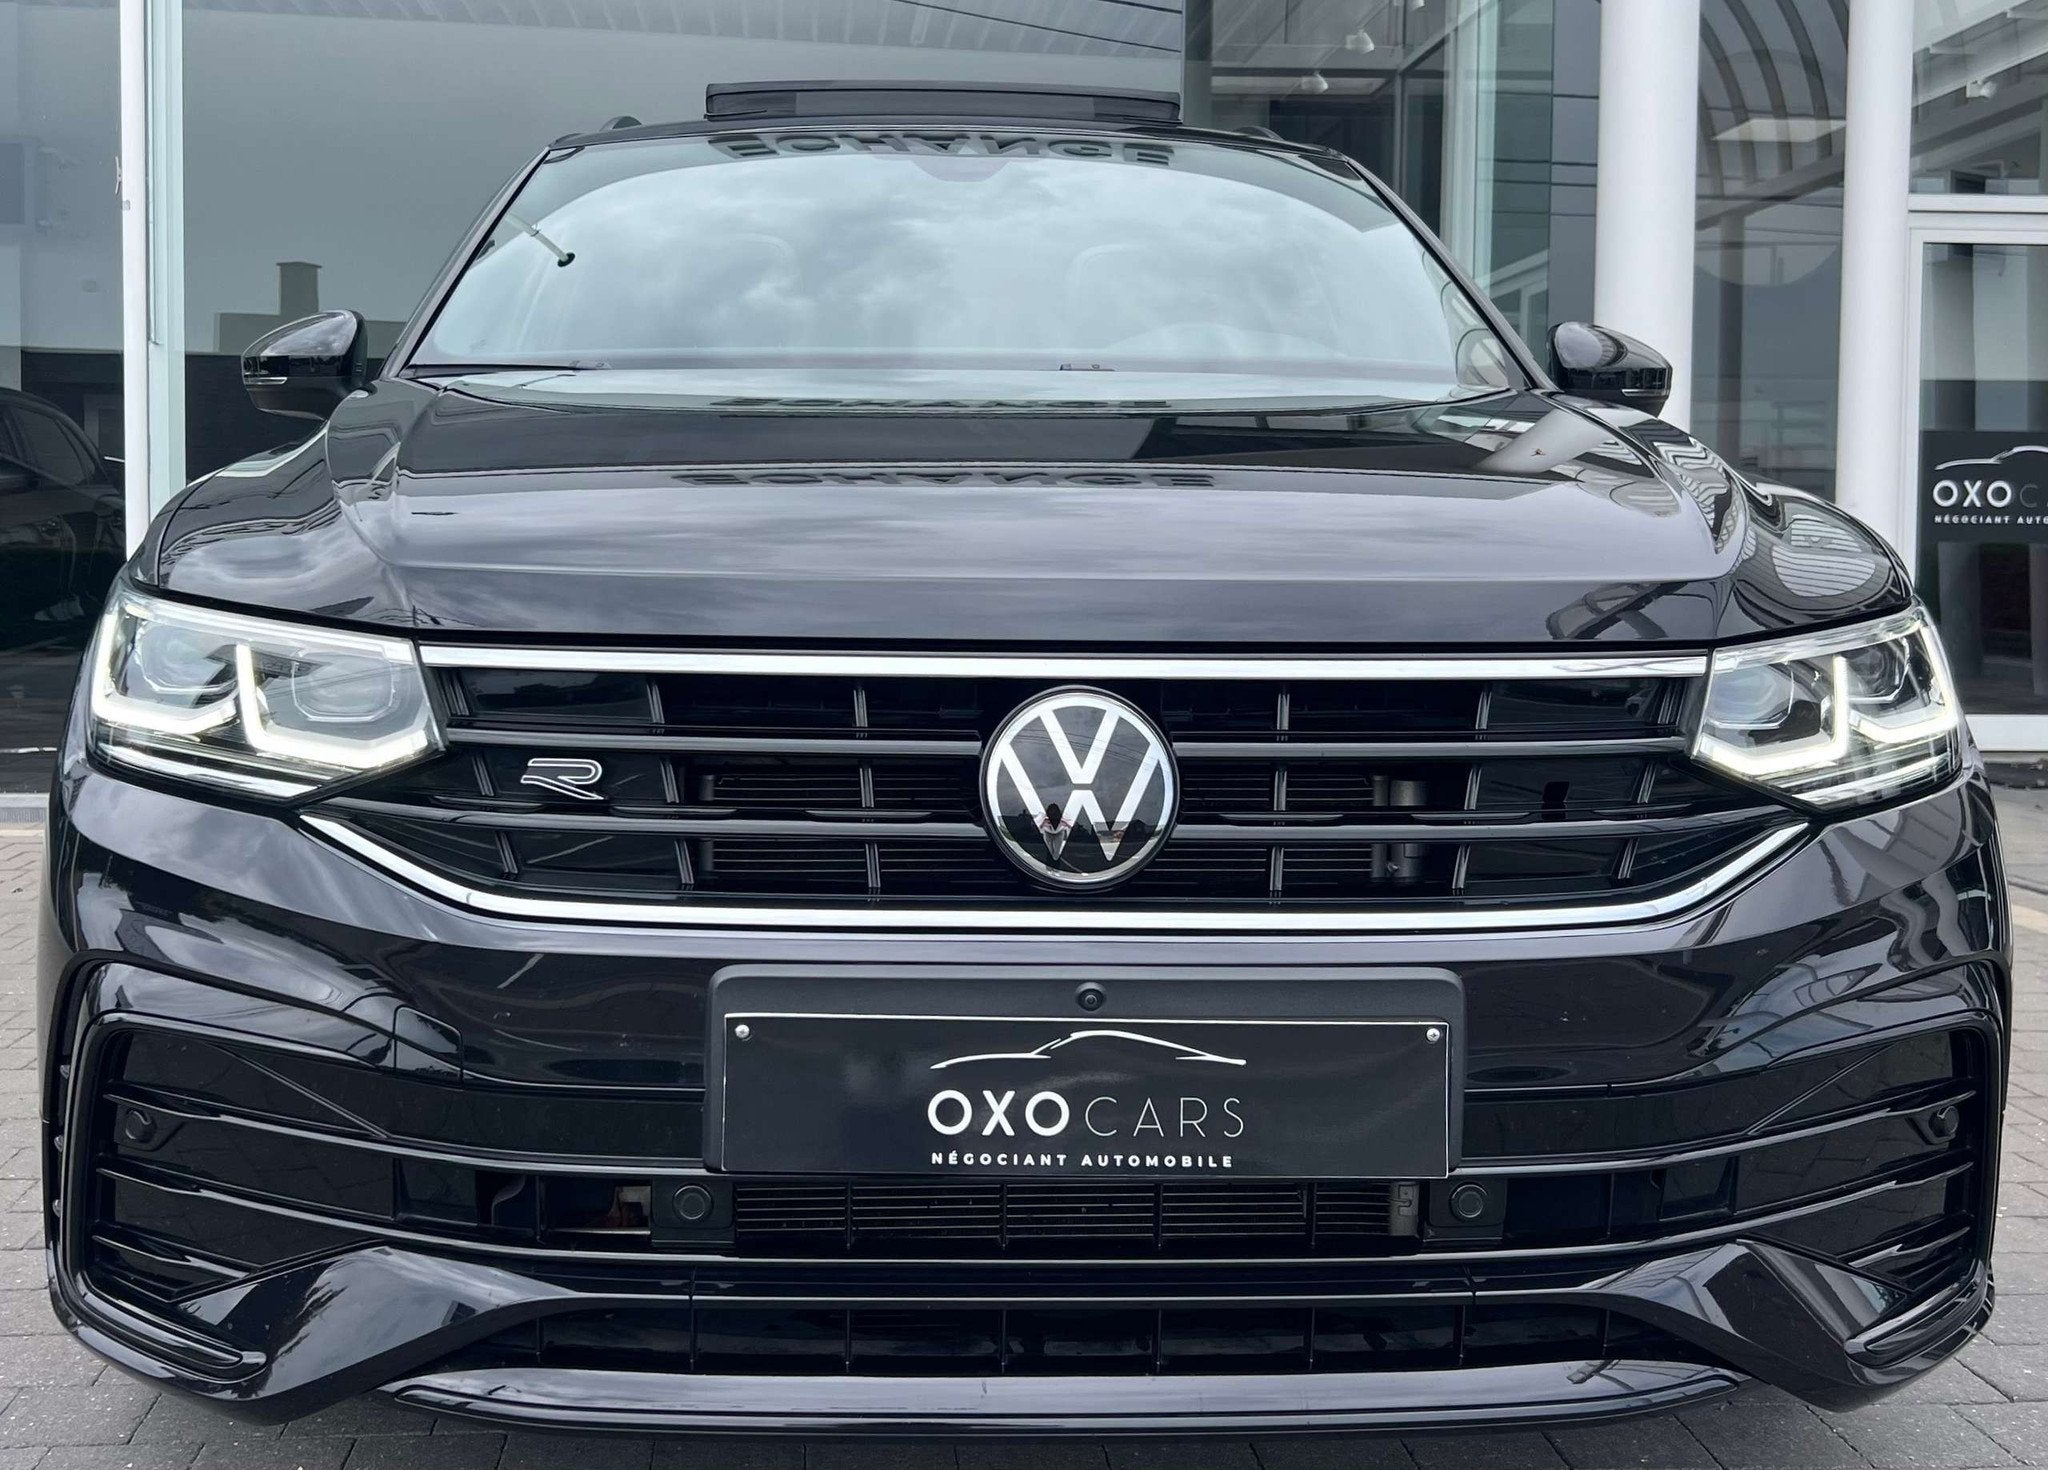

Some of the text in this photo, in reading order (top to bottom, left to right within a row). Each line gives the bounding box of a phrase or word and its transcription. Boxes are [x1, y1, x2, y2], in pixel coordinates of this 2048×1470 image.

[520, 757, 605, 800] R
[931, 1149, 1233, 1168] NÉGOCIANT AUTOMOBILE
